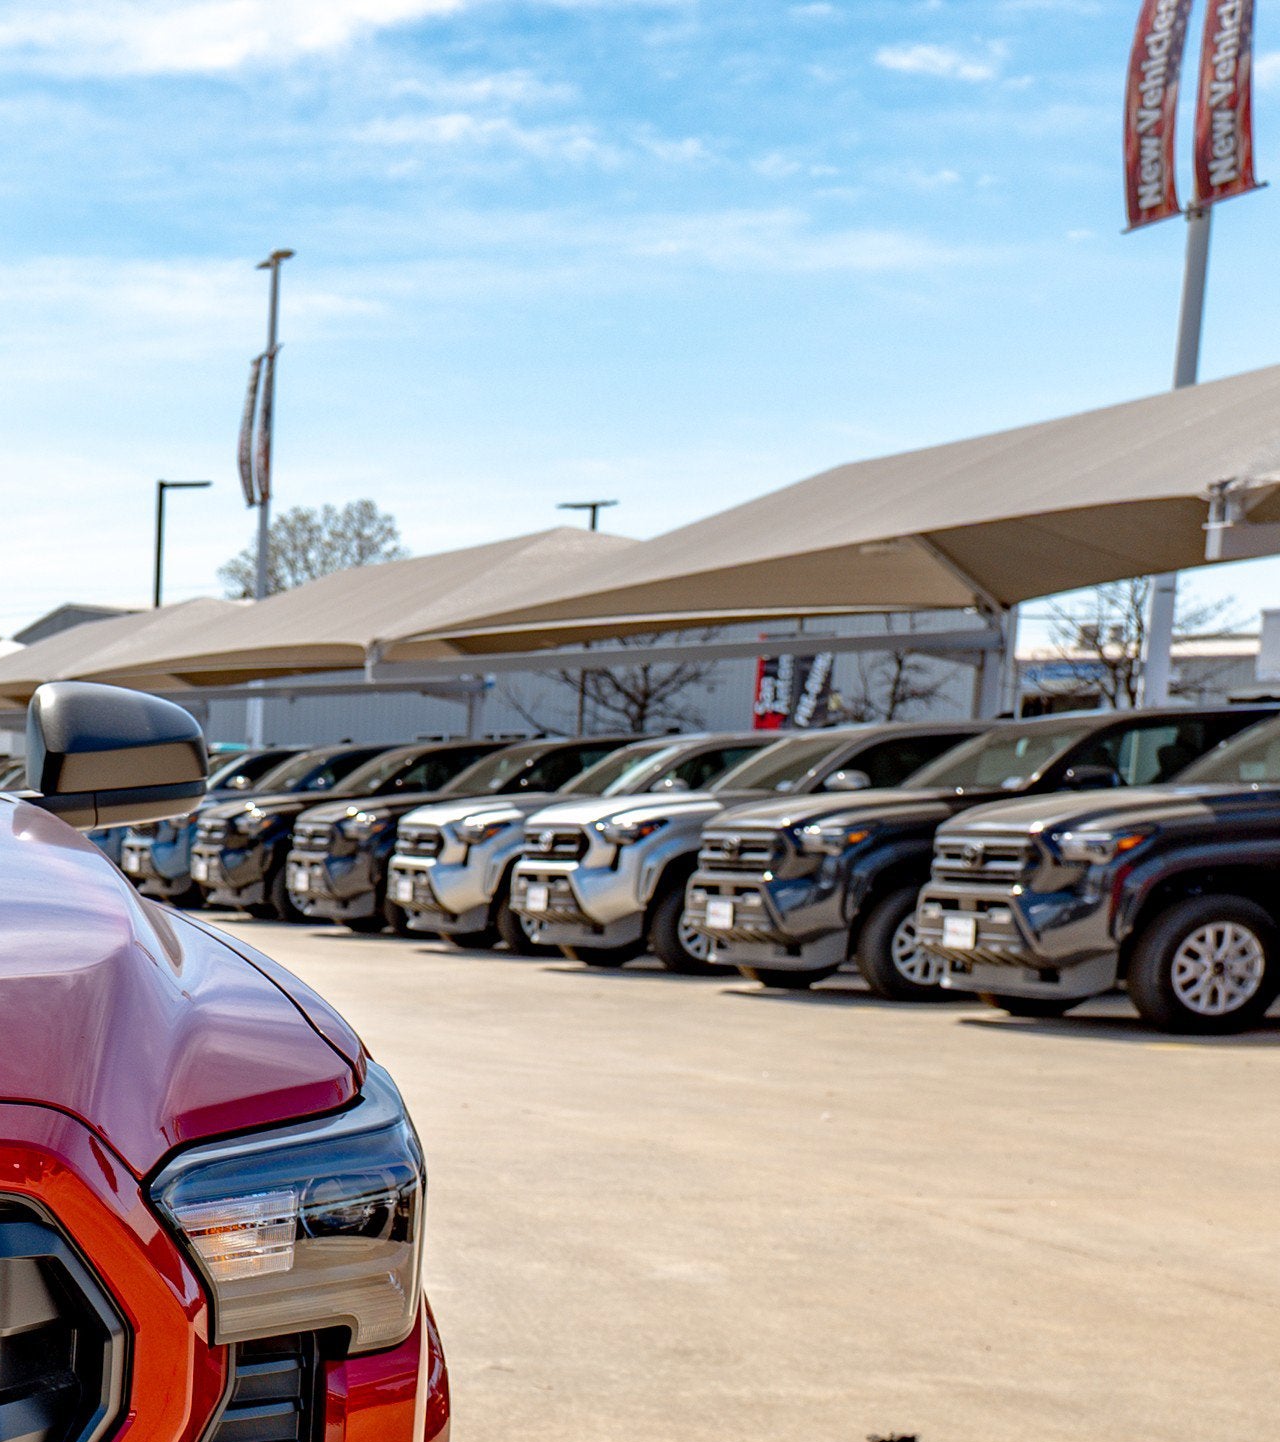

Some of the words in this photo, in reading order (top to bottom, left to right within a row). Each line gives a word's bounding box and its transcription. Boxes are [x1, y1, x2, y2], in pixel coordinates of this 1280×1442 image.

[1207, 0, 1242, 107] Vehicl
[1137, 136, 1164, 210] New
[1208, 110, 1239, 186] New
